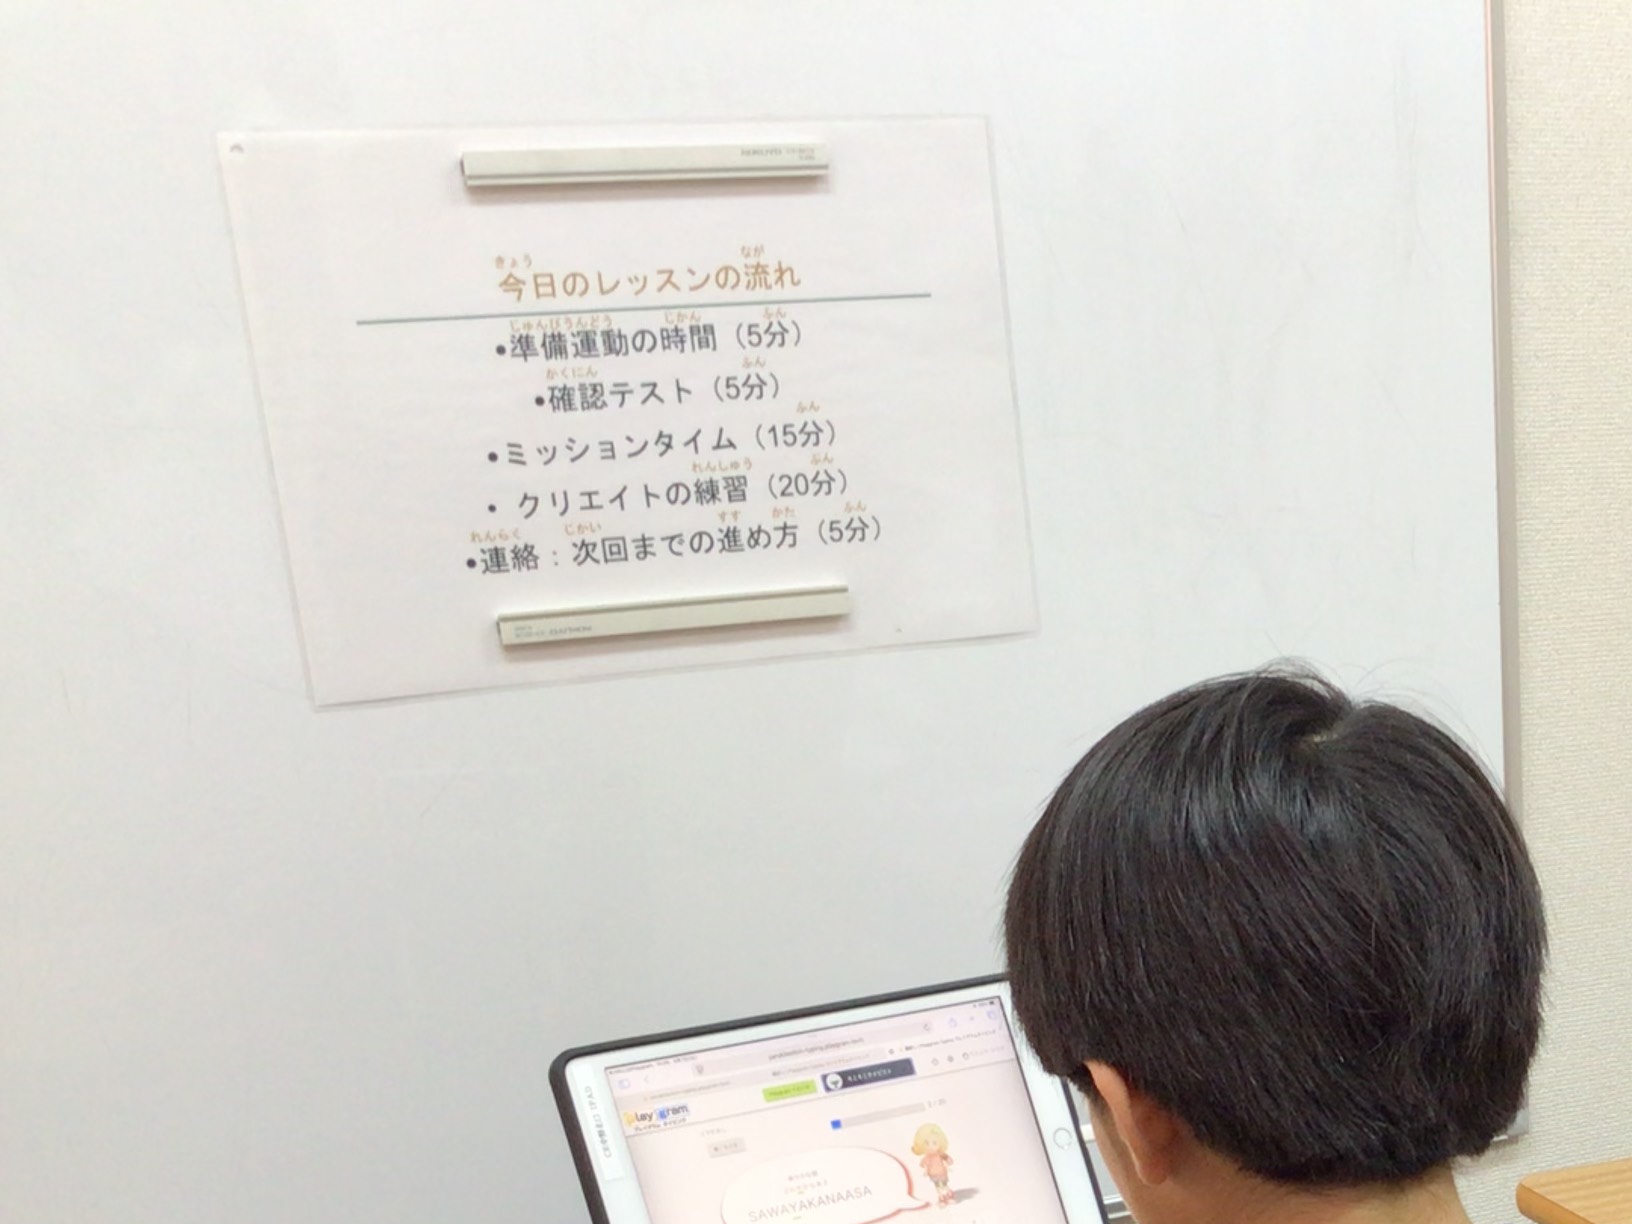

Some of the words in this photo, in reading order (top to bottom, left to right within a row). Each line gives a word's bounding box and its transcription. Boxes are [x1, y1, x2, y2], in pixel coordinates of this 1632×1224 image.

[495, 253, 533, 269] きょう
[740, 245, 765, 259] なが
[498, 261, 801, 302] 今日のレッスンの流れ
[664, 311, 701, 325] じかん
[546, 364, 598, 380] かくにん
[692, 457, 752, 473] れんしゅう
[470, 528, 521, 543] れんらく
[564, 520, 602, 536] じかい
[718, 509, 741, 523] すす
[772, 506, 796, 519] かた
[748, 1185, 872, 1223] SAWAYAKANAASA
